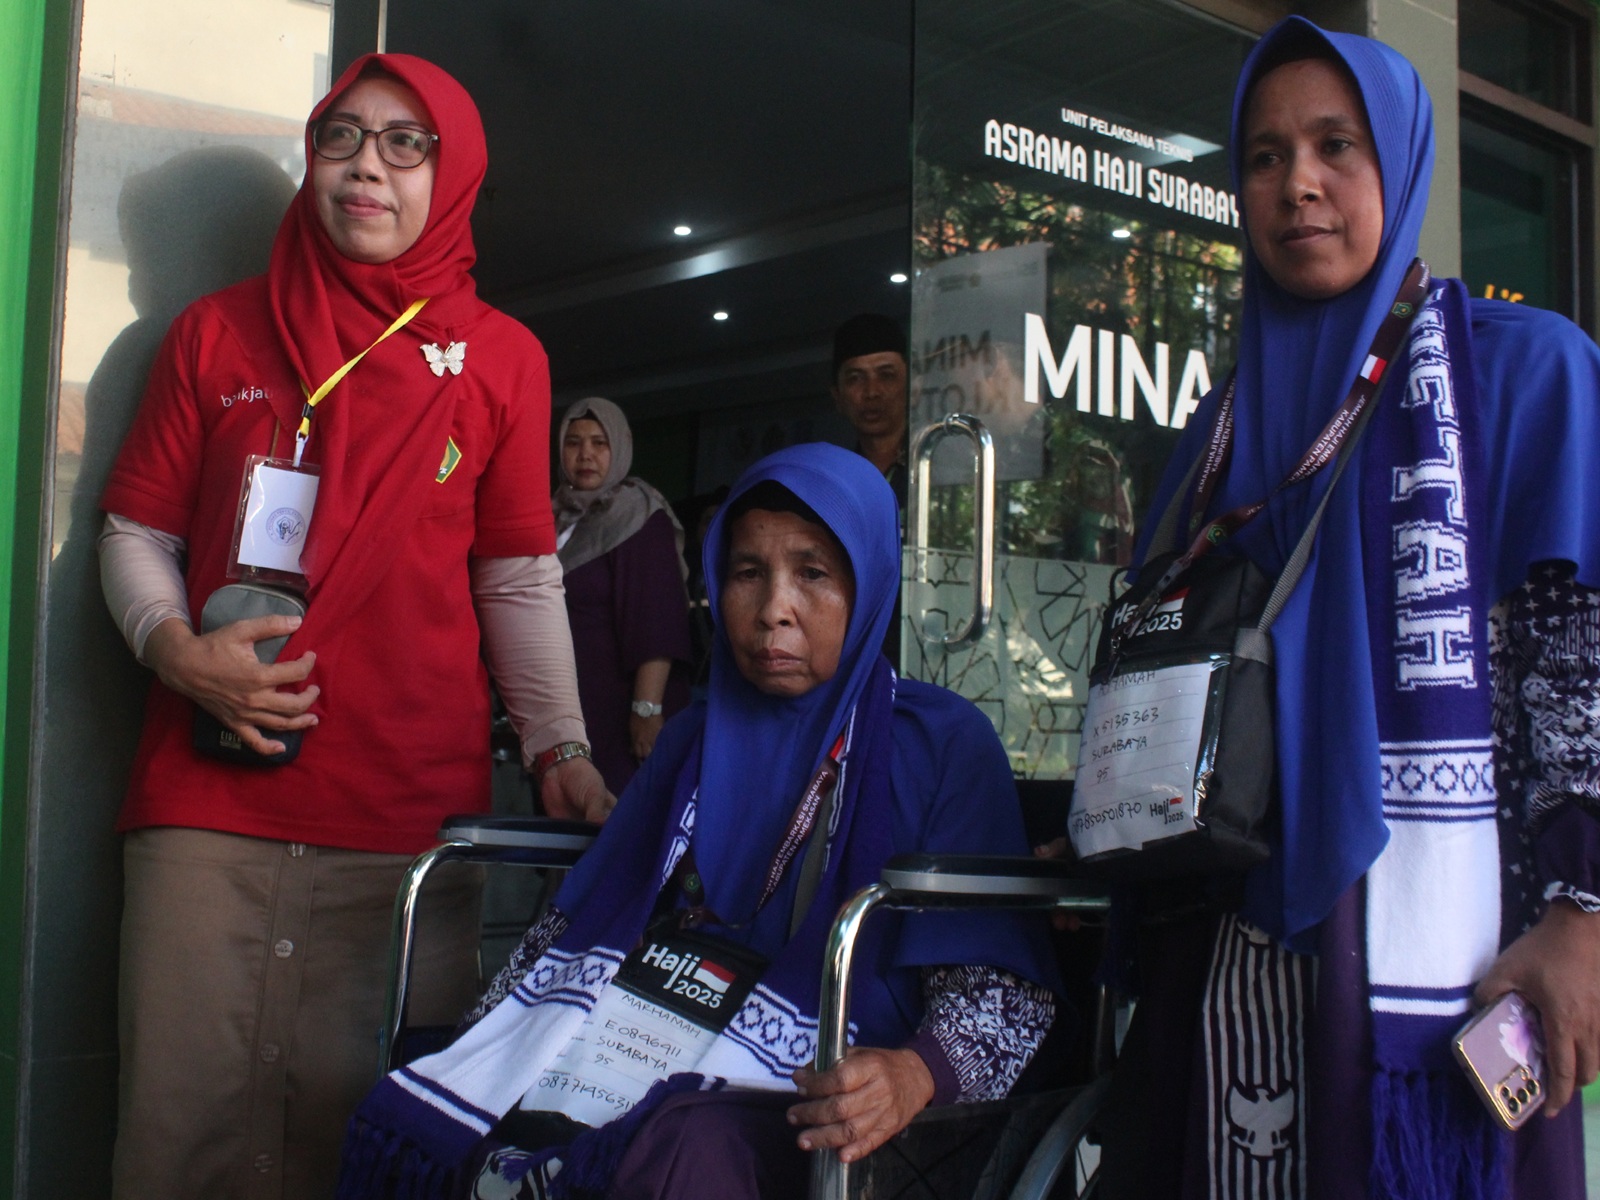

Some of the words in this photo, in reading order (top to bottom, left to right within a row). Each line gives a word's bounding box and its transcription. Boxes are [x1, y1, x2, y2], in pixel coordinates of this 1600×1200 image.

[1061, 108, 1088, 129] UNIT
[1089, 116, 1155, 151] PELAKSANA
[1155, 138, 1194, 162] TEKNIS
[985, 119, 1087, 183] ASRAMA
[1094, 150, 1143, 199] HAJI
[1148, 168, 1240, 229] SURABAY
[1024, 312, 1212, 430] MINA
[1212, 398, 1232, 444] EMBARKASI
[1312, 409, 1350, 457] KABUPATEN
[1331, 427, 1348, 446] HAJI
[1208, 443, 1218, 463] HAJI
[1135, 612, 1183, 636] 2025
[1091, 736, 1148, 761] SURABAYA
[777, 812, 807, 860] EMBARKASI
[802, 770, 829, 813] SURABAYA
[794, 795, 821, 846] PAMEKASAN
[1149, 798, 1170, 825] Haji
[1168, 812, 1185, 823] 2025
[641, 943, 701, 990] Haji
[622, 992, 701, 1038] MARHAMAH
[673, 979, 724, 1010] 2025
[597, 1035, 669, 1073] SURABAYA
